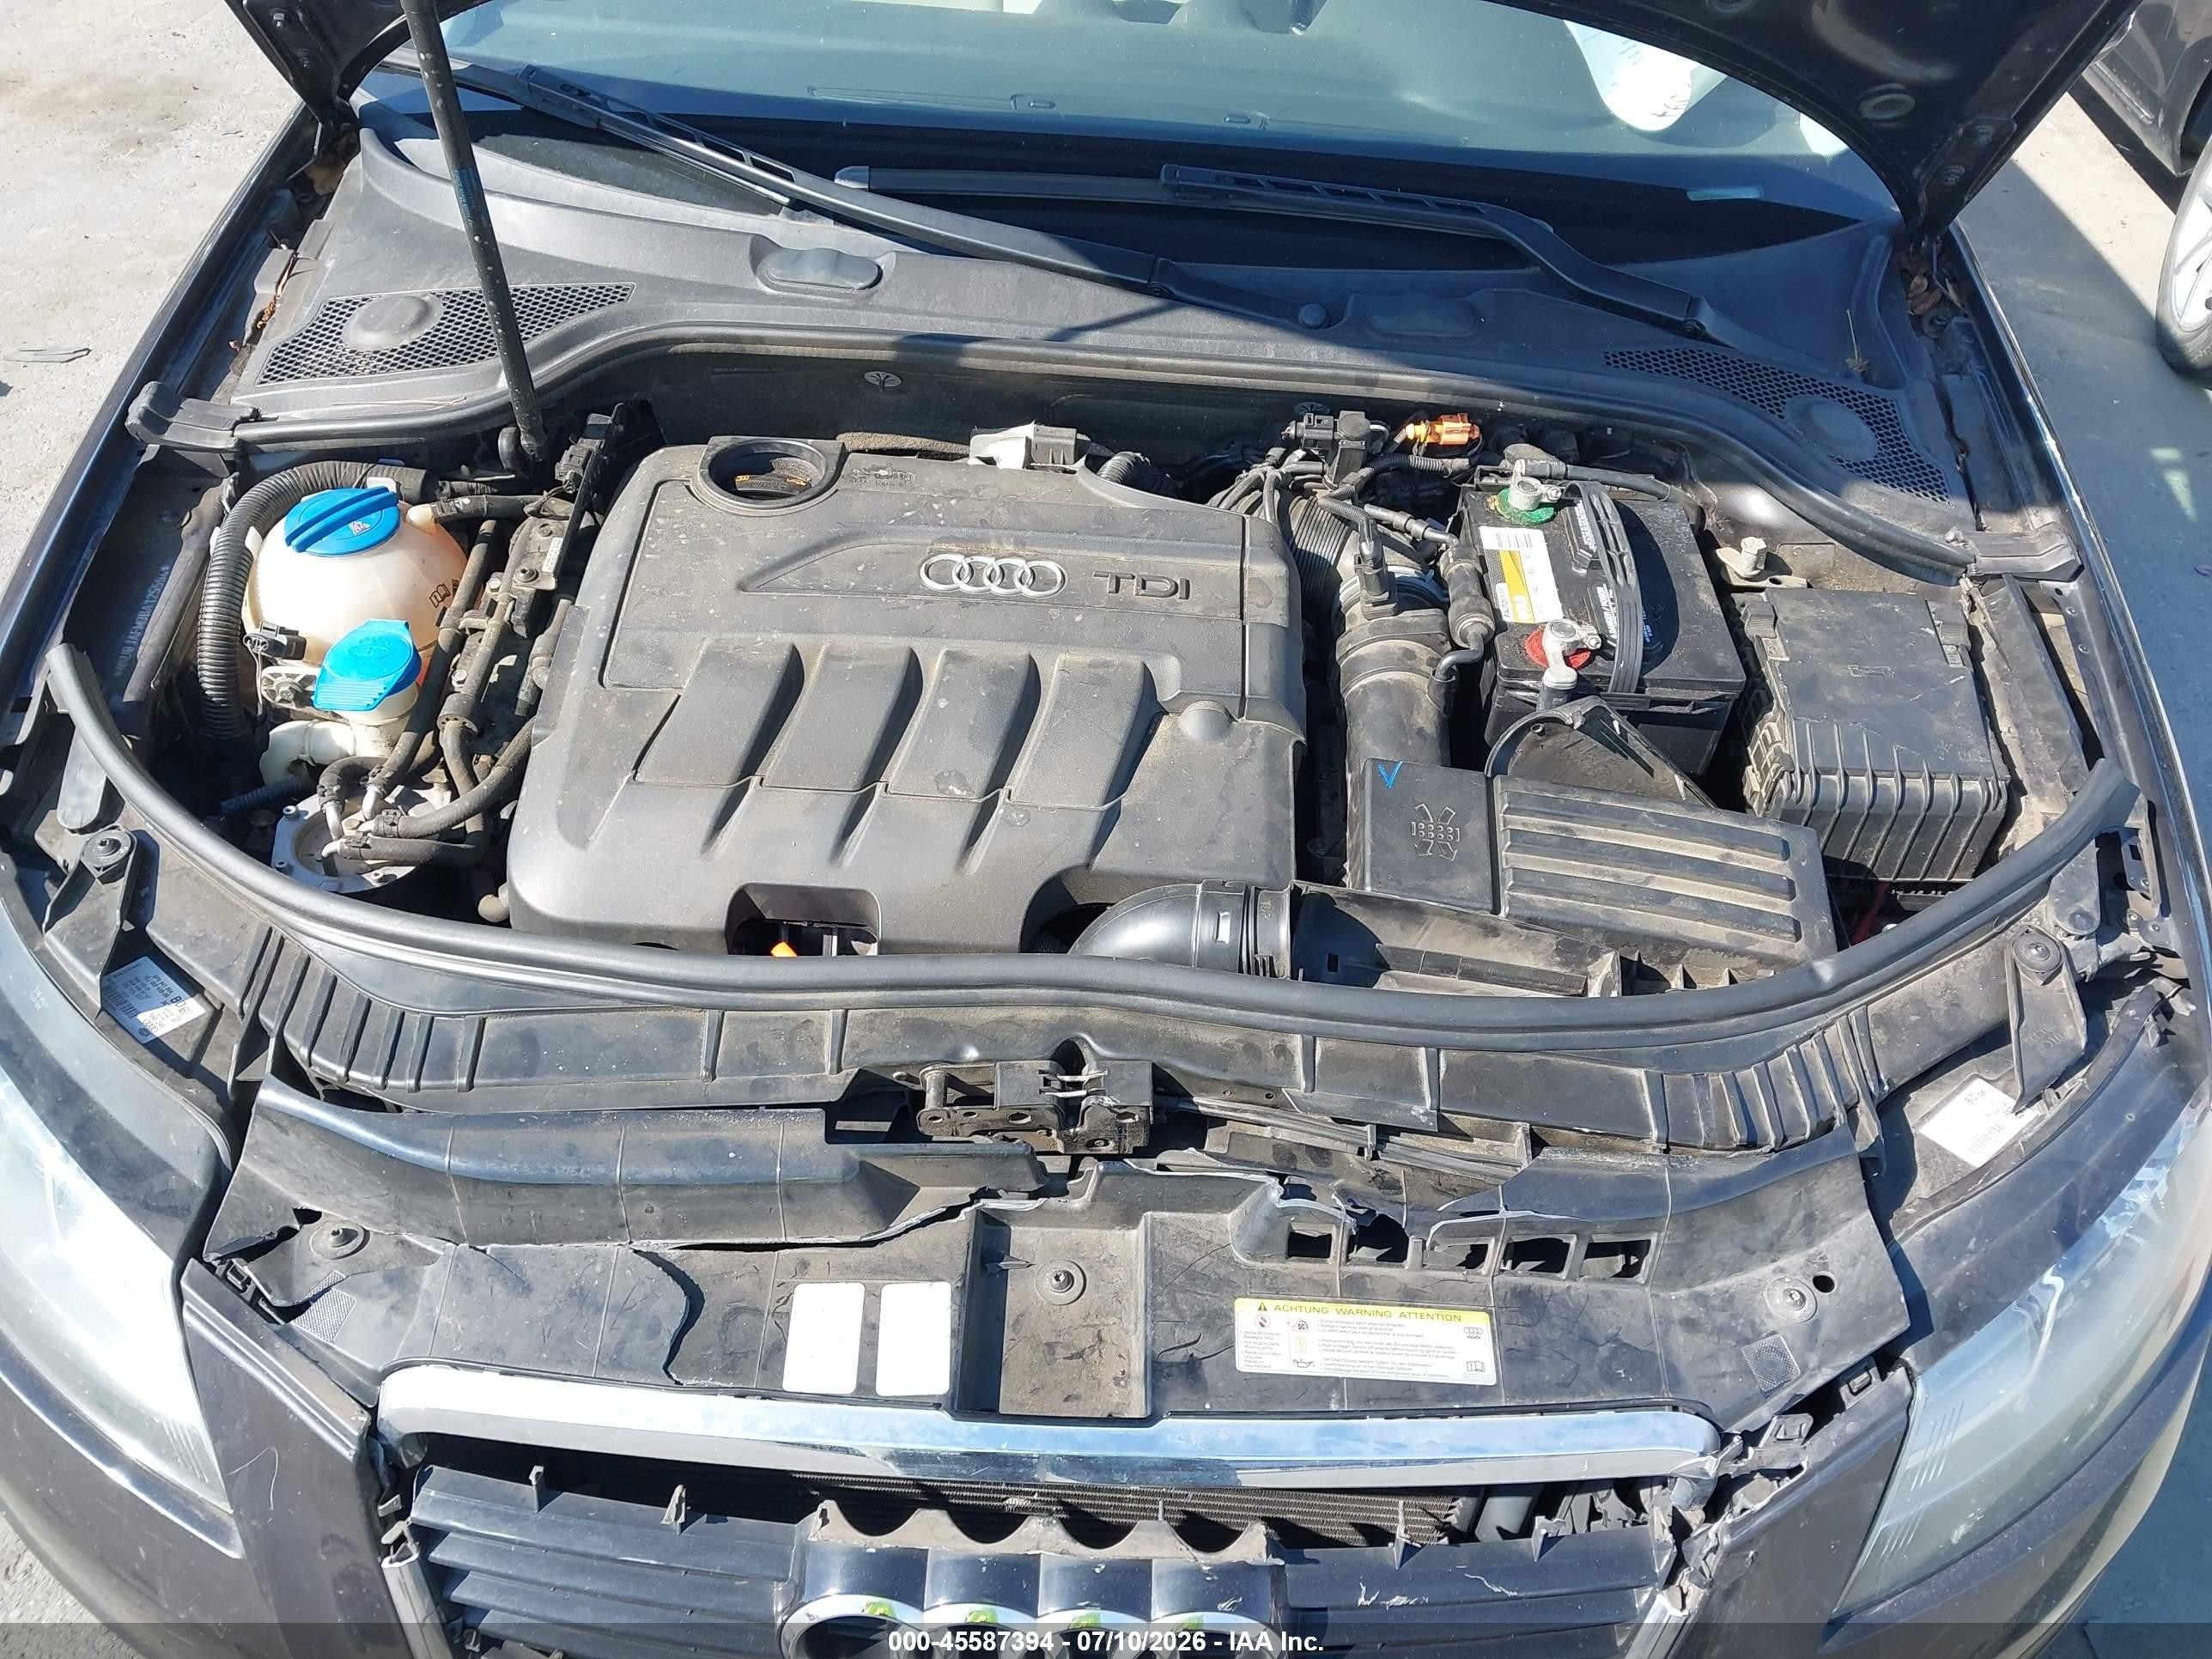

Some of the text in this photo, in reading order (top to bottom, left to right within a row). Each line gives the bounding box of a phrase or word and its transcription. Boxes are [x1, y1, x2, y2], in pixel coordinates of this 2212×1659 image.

[1092, 570, 1190, 600] TDI
[1273, 1304, 1462, 1322] ACHTUNG WARNING ATTENTION
